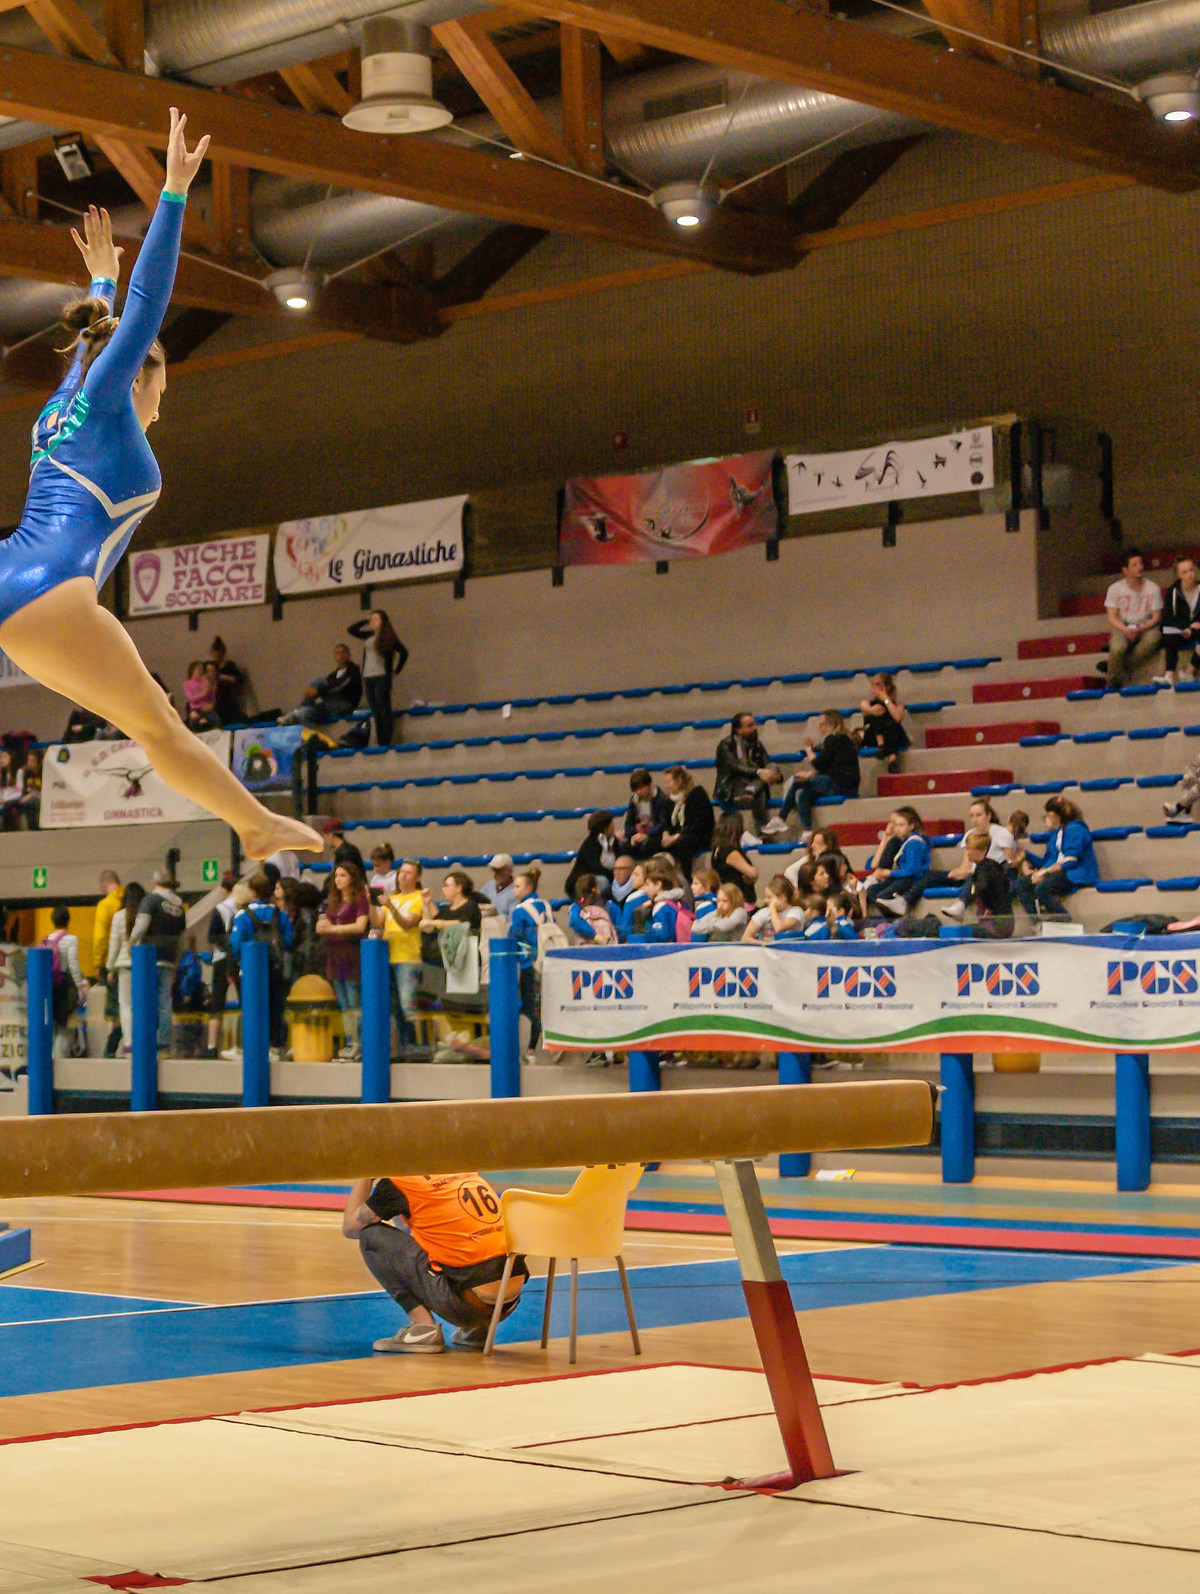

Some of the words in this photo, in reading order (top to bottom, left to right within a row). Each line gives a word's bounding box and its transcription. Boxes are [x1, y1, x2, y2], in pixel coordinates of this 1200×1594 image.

[173, 540, 256, 567] NICHE
[328, 555, 344, 583] Le
[353, 539, 457, 580] Ginnastiche
[173, 562, 256, 590] FACCI
[165, 584, 263, 608] SOGNARE
[103, 807, 164, 821] GINNASTICA
[571, 968, 634, 1000] PGS
[688, 966, 759, 998] PGS
[817, 965, 897, 998] PGS
[956, 962, 1040, 996] PGS
[1107, 959, 1199, 996] PGS
[461, 1185, 499, 1217] 16
